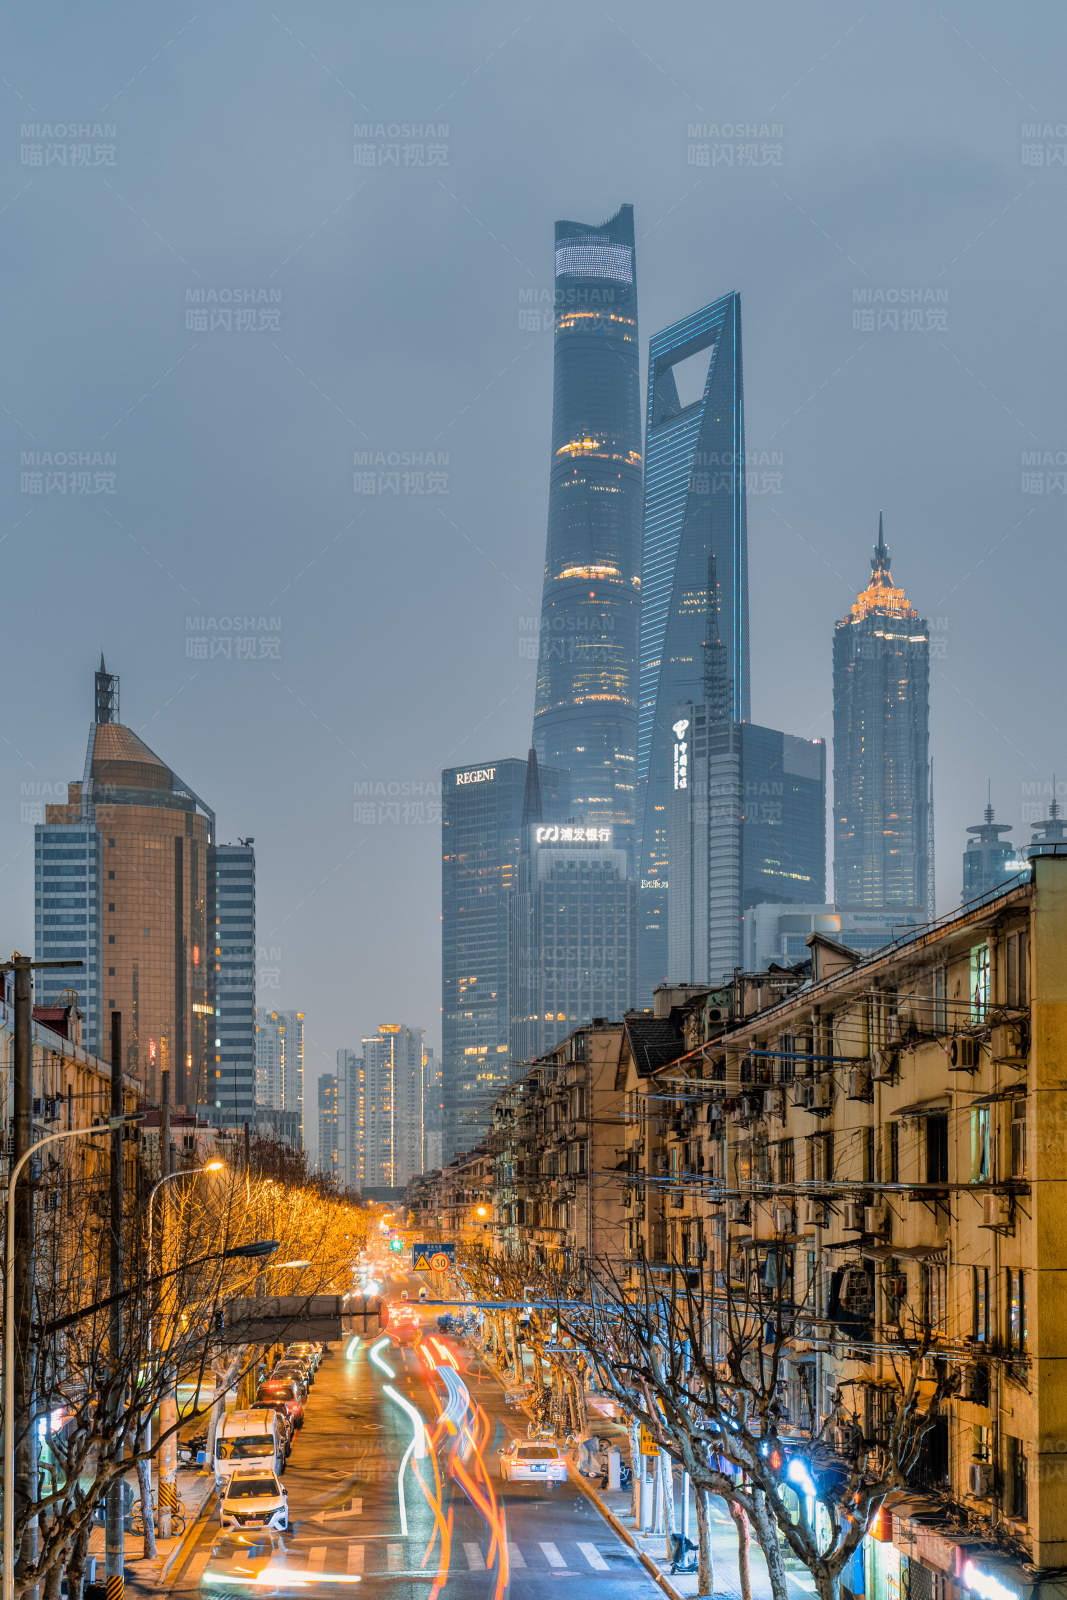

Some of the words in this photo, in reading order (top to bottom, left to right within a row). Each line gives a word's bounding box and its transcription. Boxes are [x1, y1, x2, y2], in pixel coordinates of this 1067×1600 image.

[456, 768, 496, 785] REGENT
[560, 827, 612, 841] 浦发银行
[434, 1258, 446, 1268] 30
